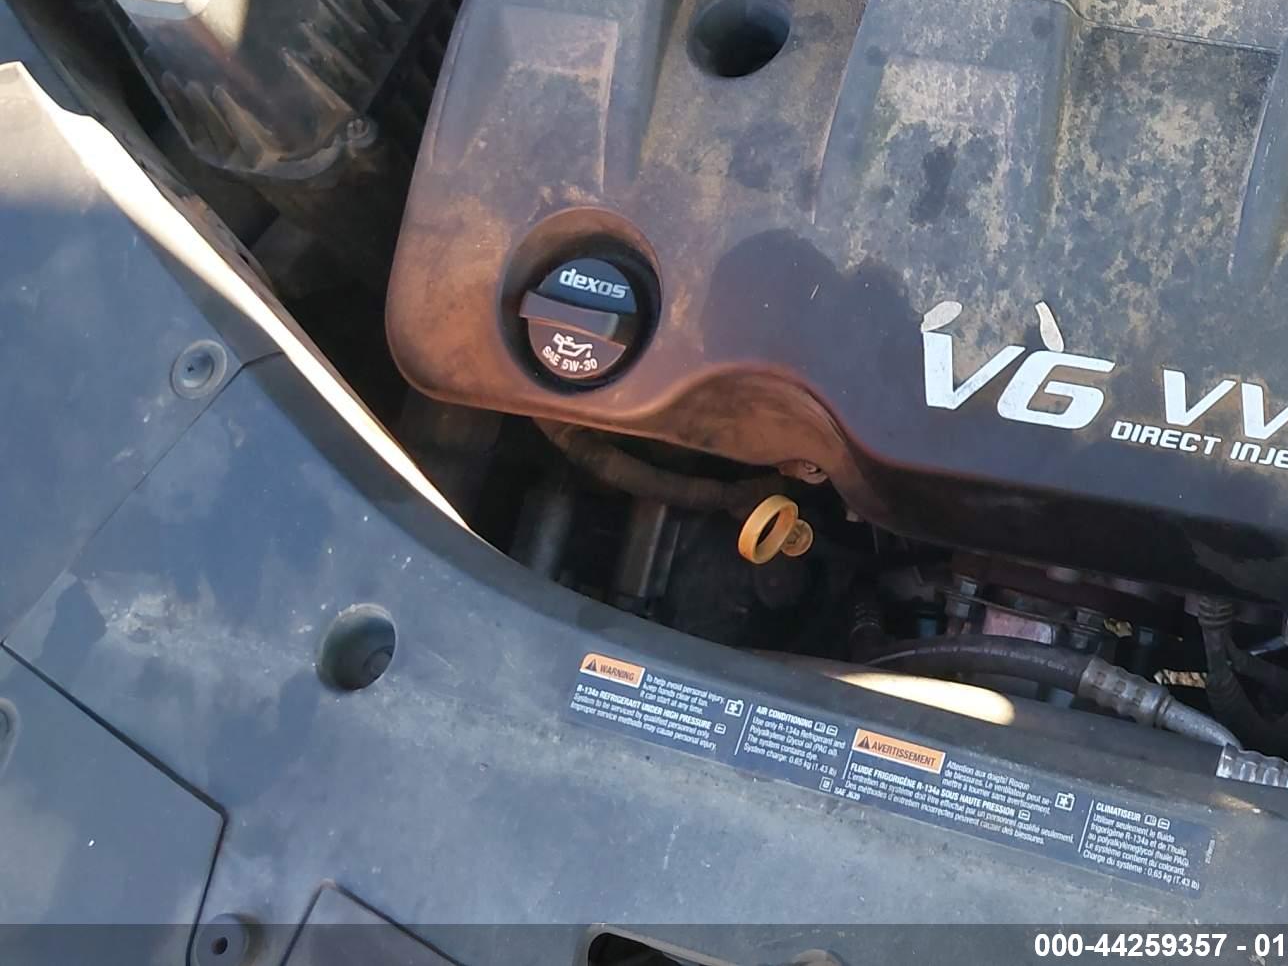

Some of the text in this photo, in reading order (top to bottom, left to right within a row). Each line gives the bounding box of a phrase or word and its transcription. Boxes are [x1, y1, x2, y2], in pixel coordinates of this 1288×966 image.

[559, 268, 630, 299] dexos
[542, 346, 597, 372] SAE 5W-30
[923, 332, 1116, 430] V6
[1111, 420, 1221, 456] DIRECT
[599, 664, 635, 681] WARNING
[644, 673, 653, 683] To
[652, 676, 666, 687] help
[666, 679, 683, 691] avoid
[576, 683, 712, 729] R-134a REFRIGERANT UNDER HIGH PRESSURE
[755, 705, 813, 728] AIR CONDITIONING
[871, 740, 936, 767] AVERTISSEMENT
[849, 762, 873, 776] FLUIDE
[915, 781, 940, 795] R-134a
[940, 788, 959, 801] SOUS
[958, 793, 982, 807] HAUTE
[981, 800, 1015, 817] PRESSION
[1095, 802, 1141, 822] CLIMATISEUR
[1124, 831, 1149, 846] R-134a
